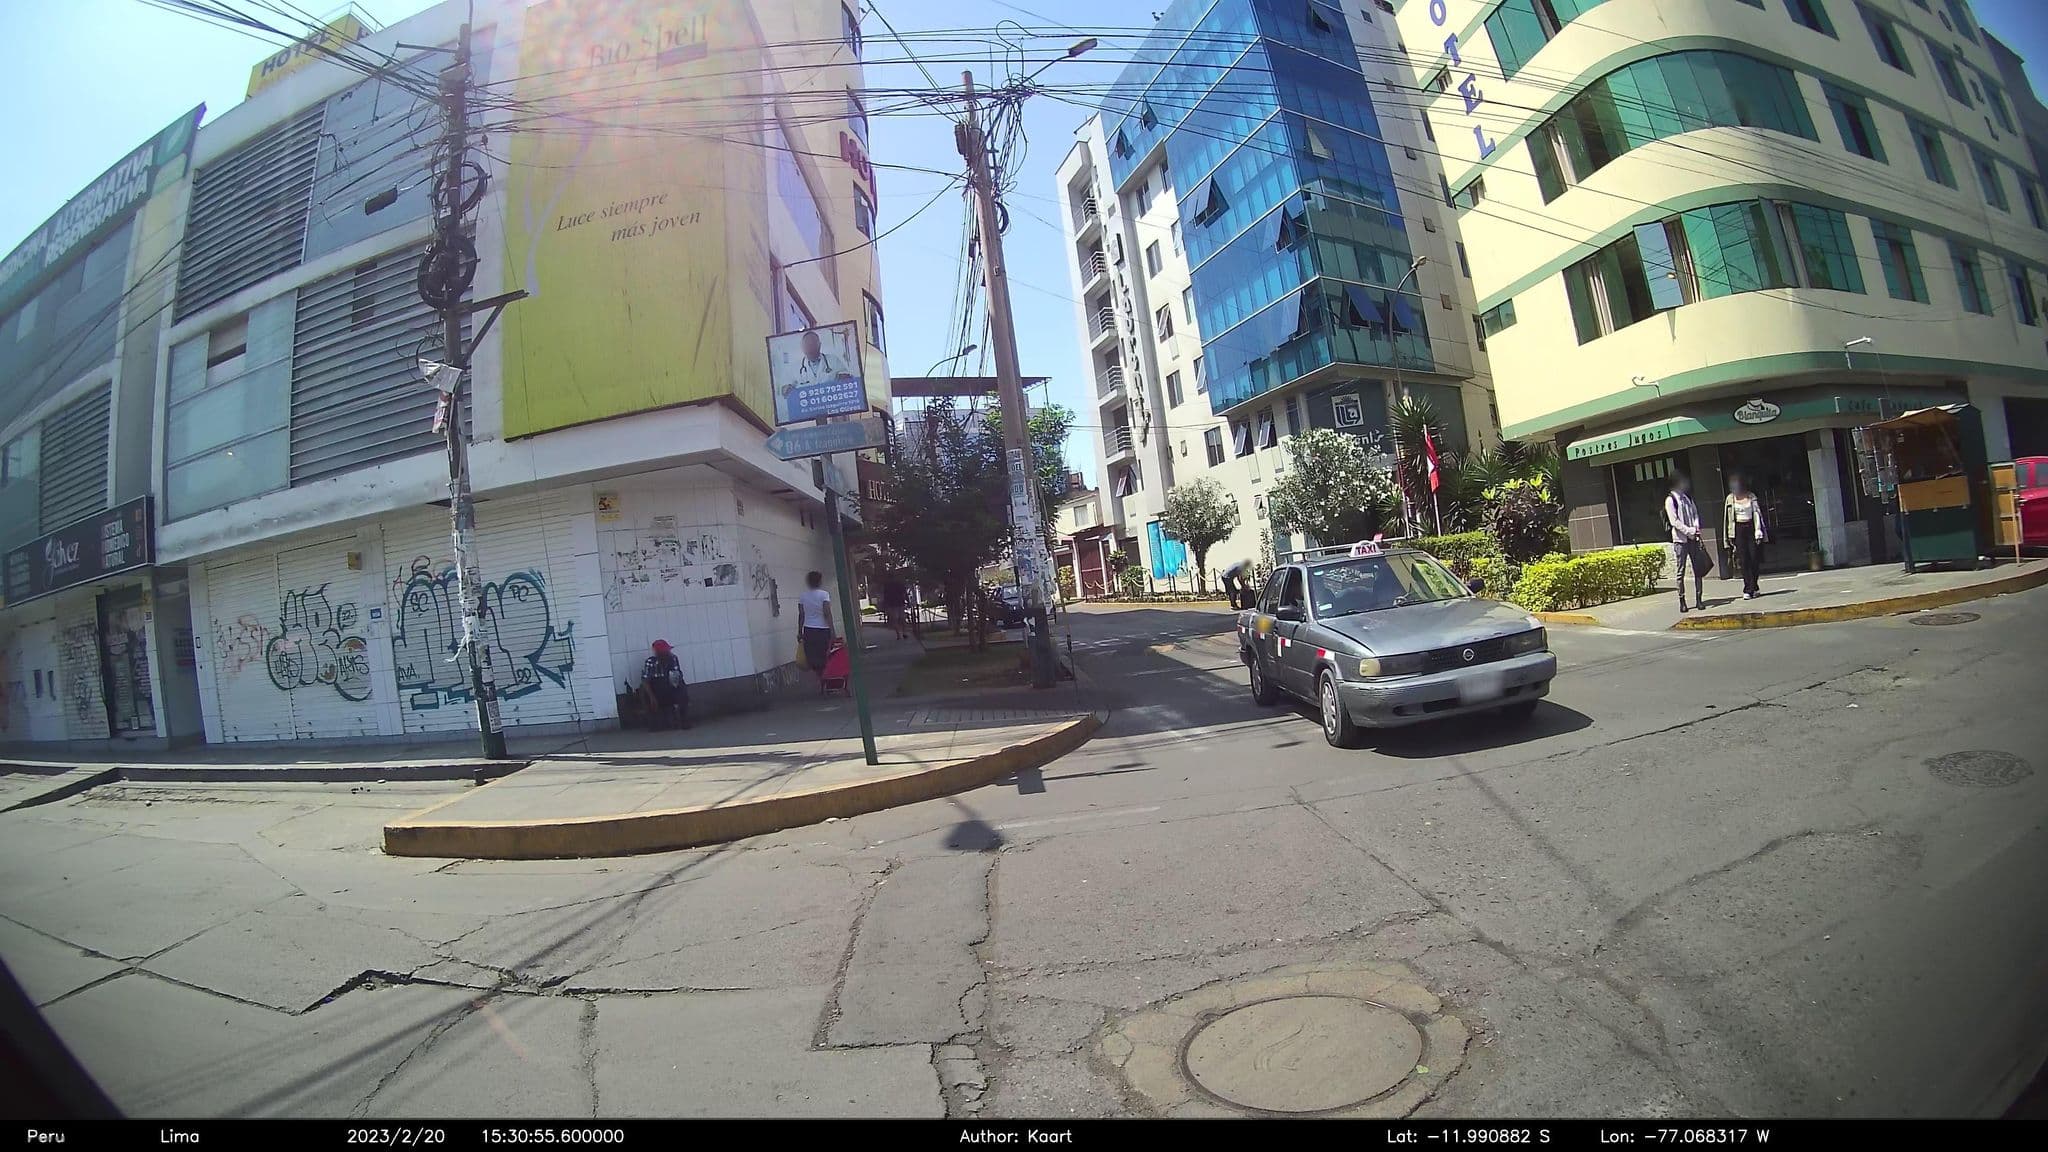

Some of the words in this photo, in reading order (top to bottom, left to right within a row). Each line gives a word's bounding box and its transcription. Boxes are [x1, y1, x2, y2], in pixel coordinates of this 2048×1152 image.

[556, 209, 595, 232] Luce
[600, 192, 669, 220] siempre
[611, 221, 646, 242] más
[648, 211, 701, 237] joven
[808, 387, 825, 397] 926
[825, 384, 842, 394] 792
[810, 396, 821, 405] 01
[1737, 407, 1777, 422] Blanquita
[1575, 441, 1618, 458] Postres
[1628, 430, 1662, 447] Jugos
[1355, 544, 1377, 555] TAXI
